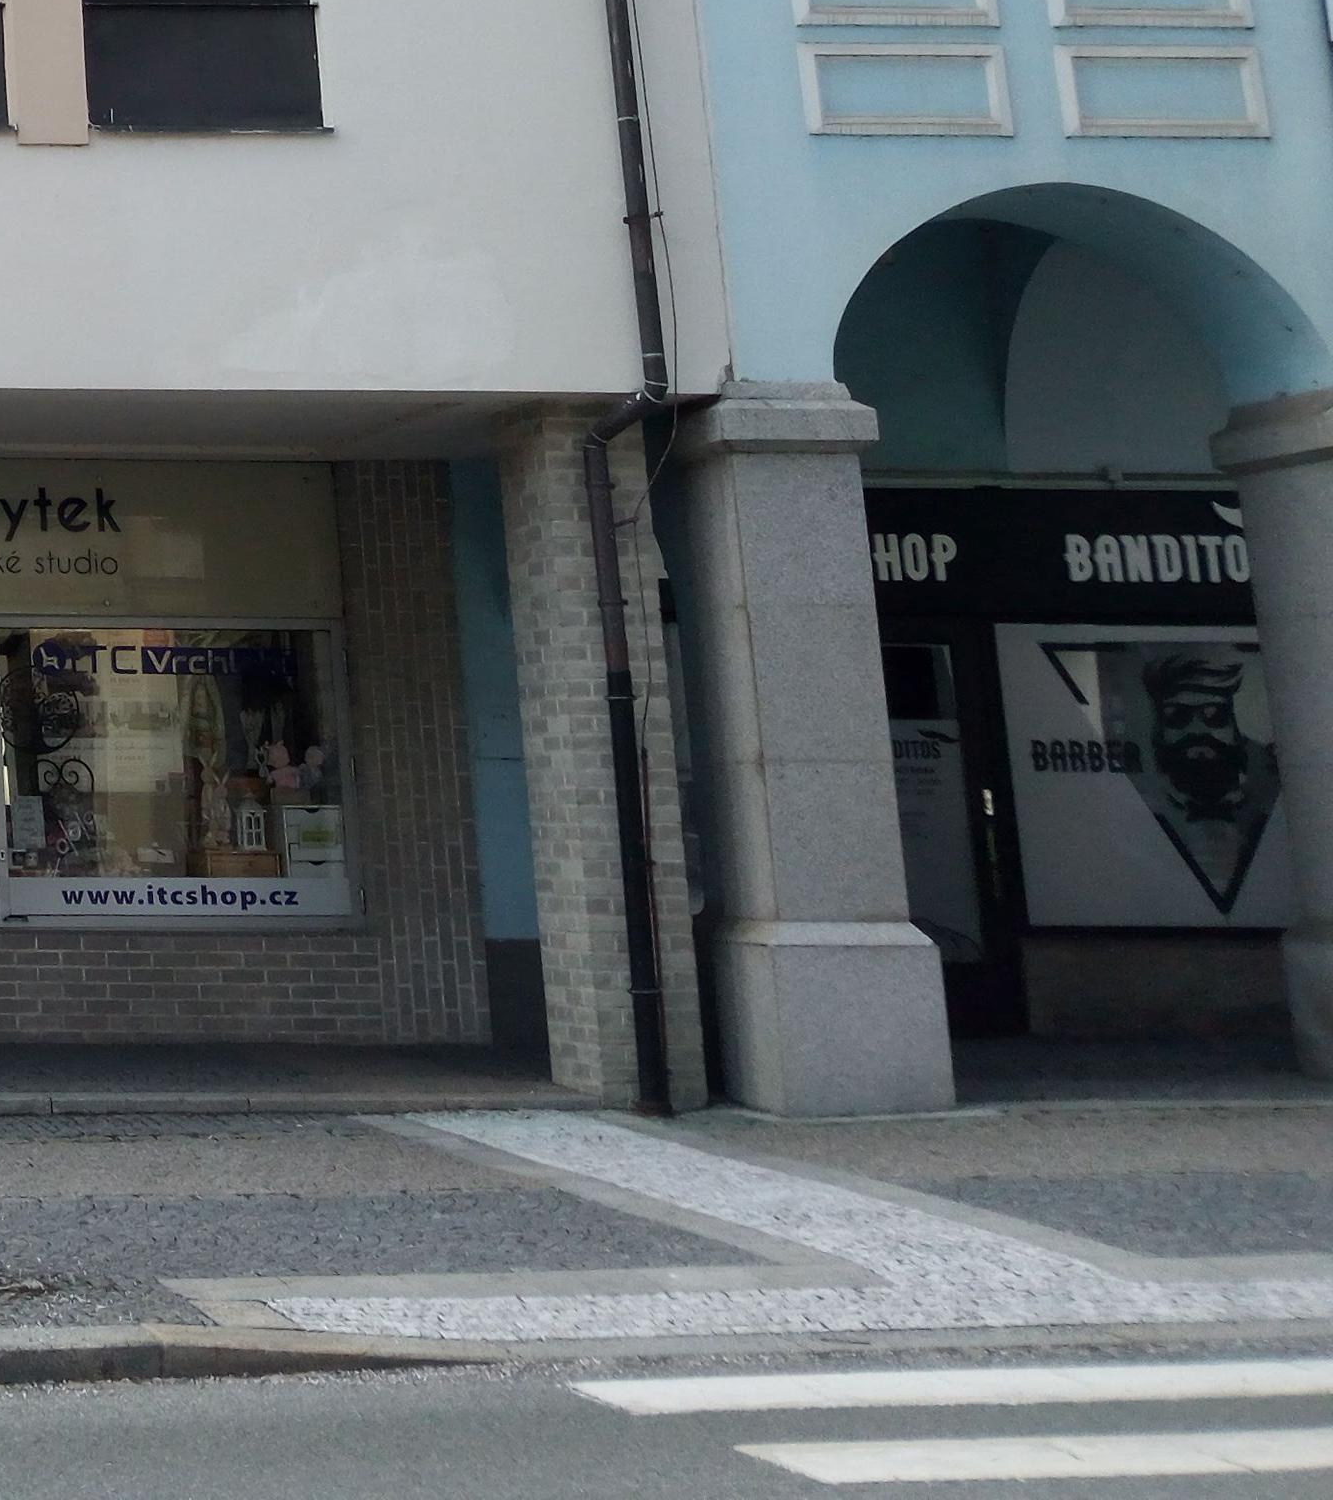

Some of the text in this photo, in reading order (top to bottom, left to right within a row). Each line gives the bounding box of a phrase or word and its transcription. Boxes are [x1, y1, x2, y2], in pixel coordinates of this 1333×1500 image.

[35, 550, 119, 575] studio
[873, 533, 1250, 583] HOP BANDITO
[893, 739, 942, 760] DITOS
[61, 884, 299, 911] www.itcshop.cz
